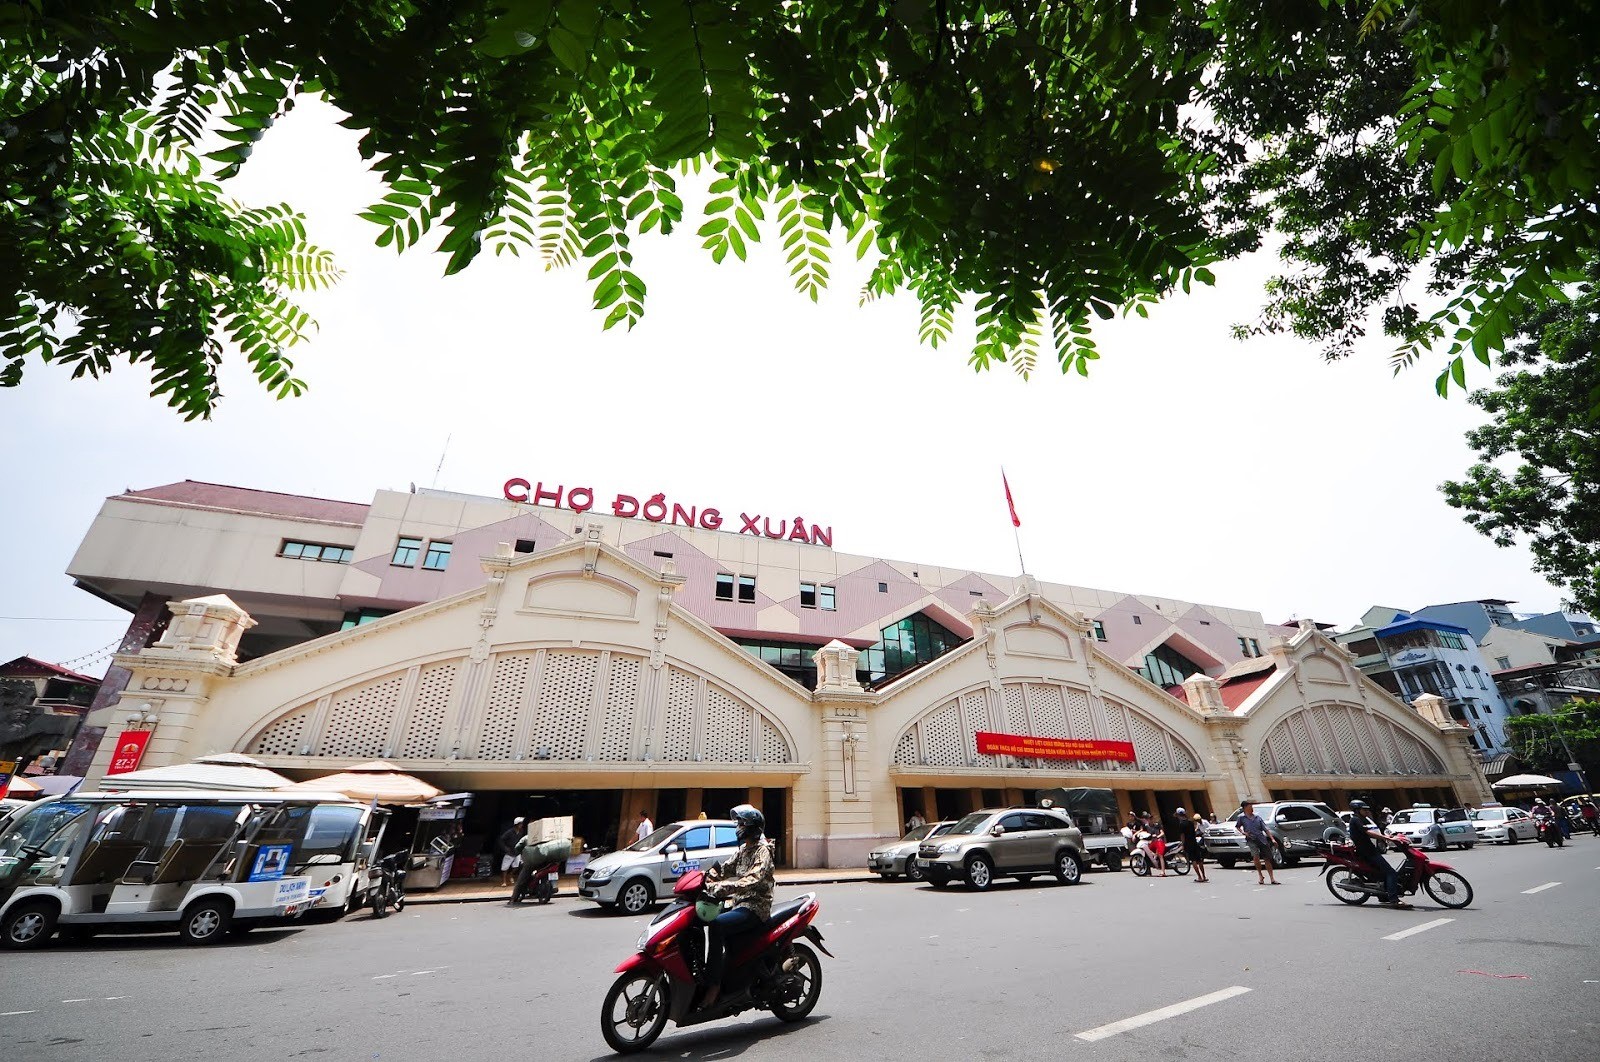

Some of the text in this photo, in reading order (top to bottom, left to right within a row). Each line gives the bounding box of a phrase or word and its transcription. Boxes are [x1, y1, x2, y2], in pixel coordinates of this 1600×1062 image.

[504, 477, 833, 547] CHỢ ĐỒNG XUÂN
[115, 758, 136, 766] 27-7
